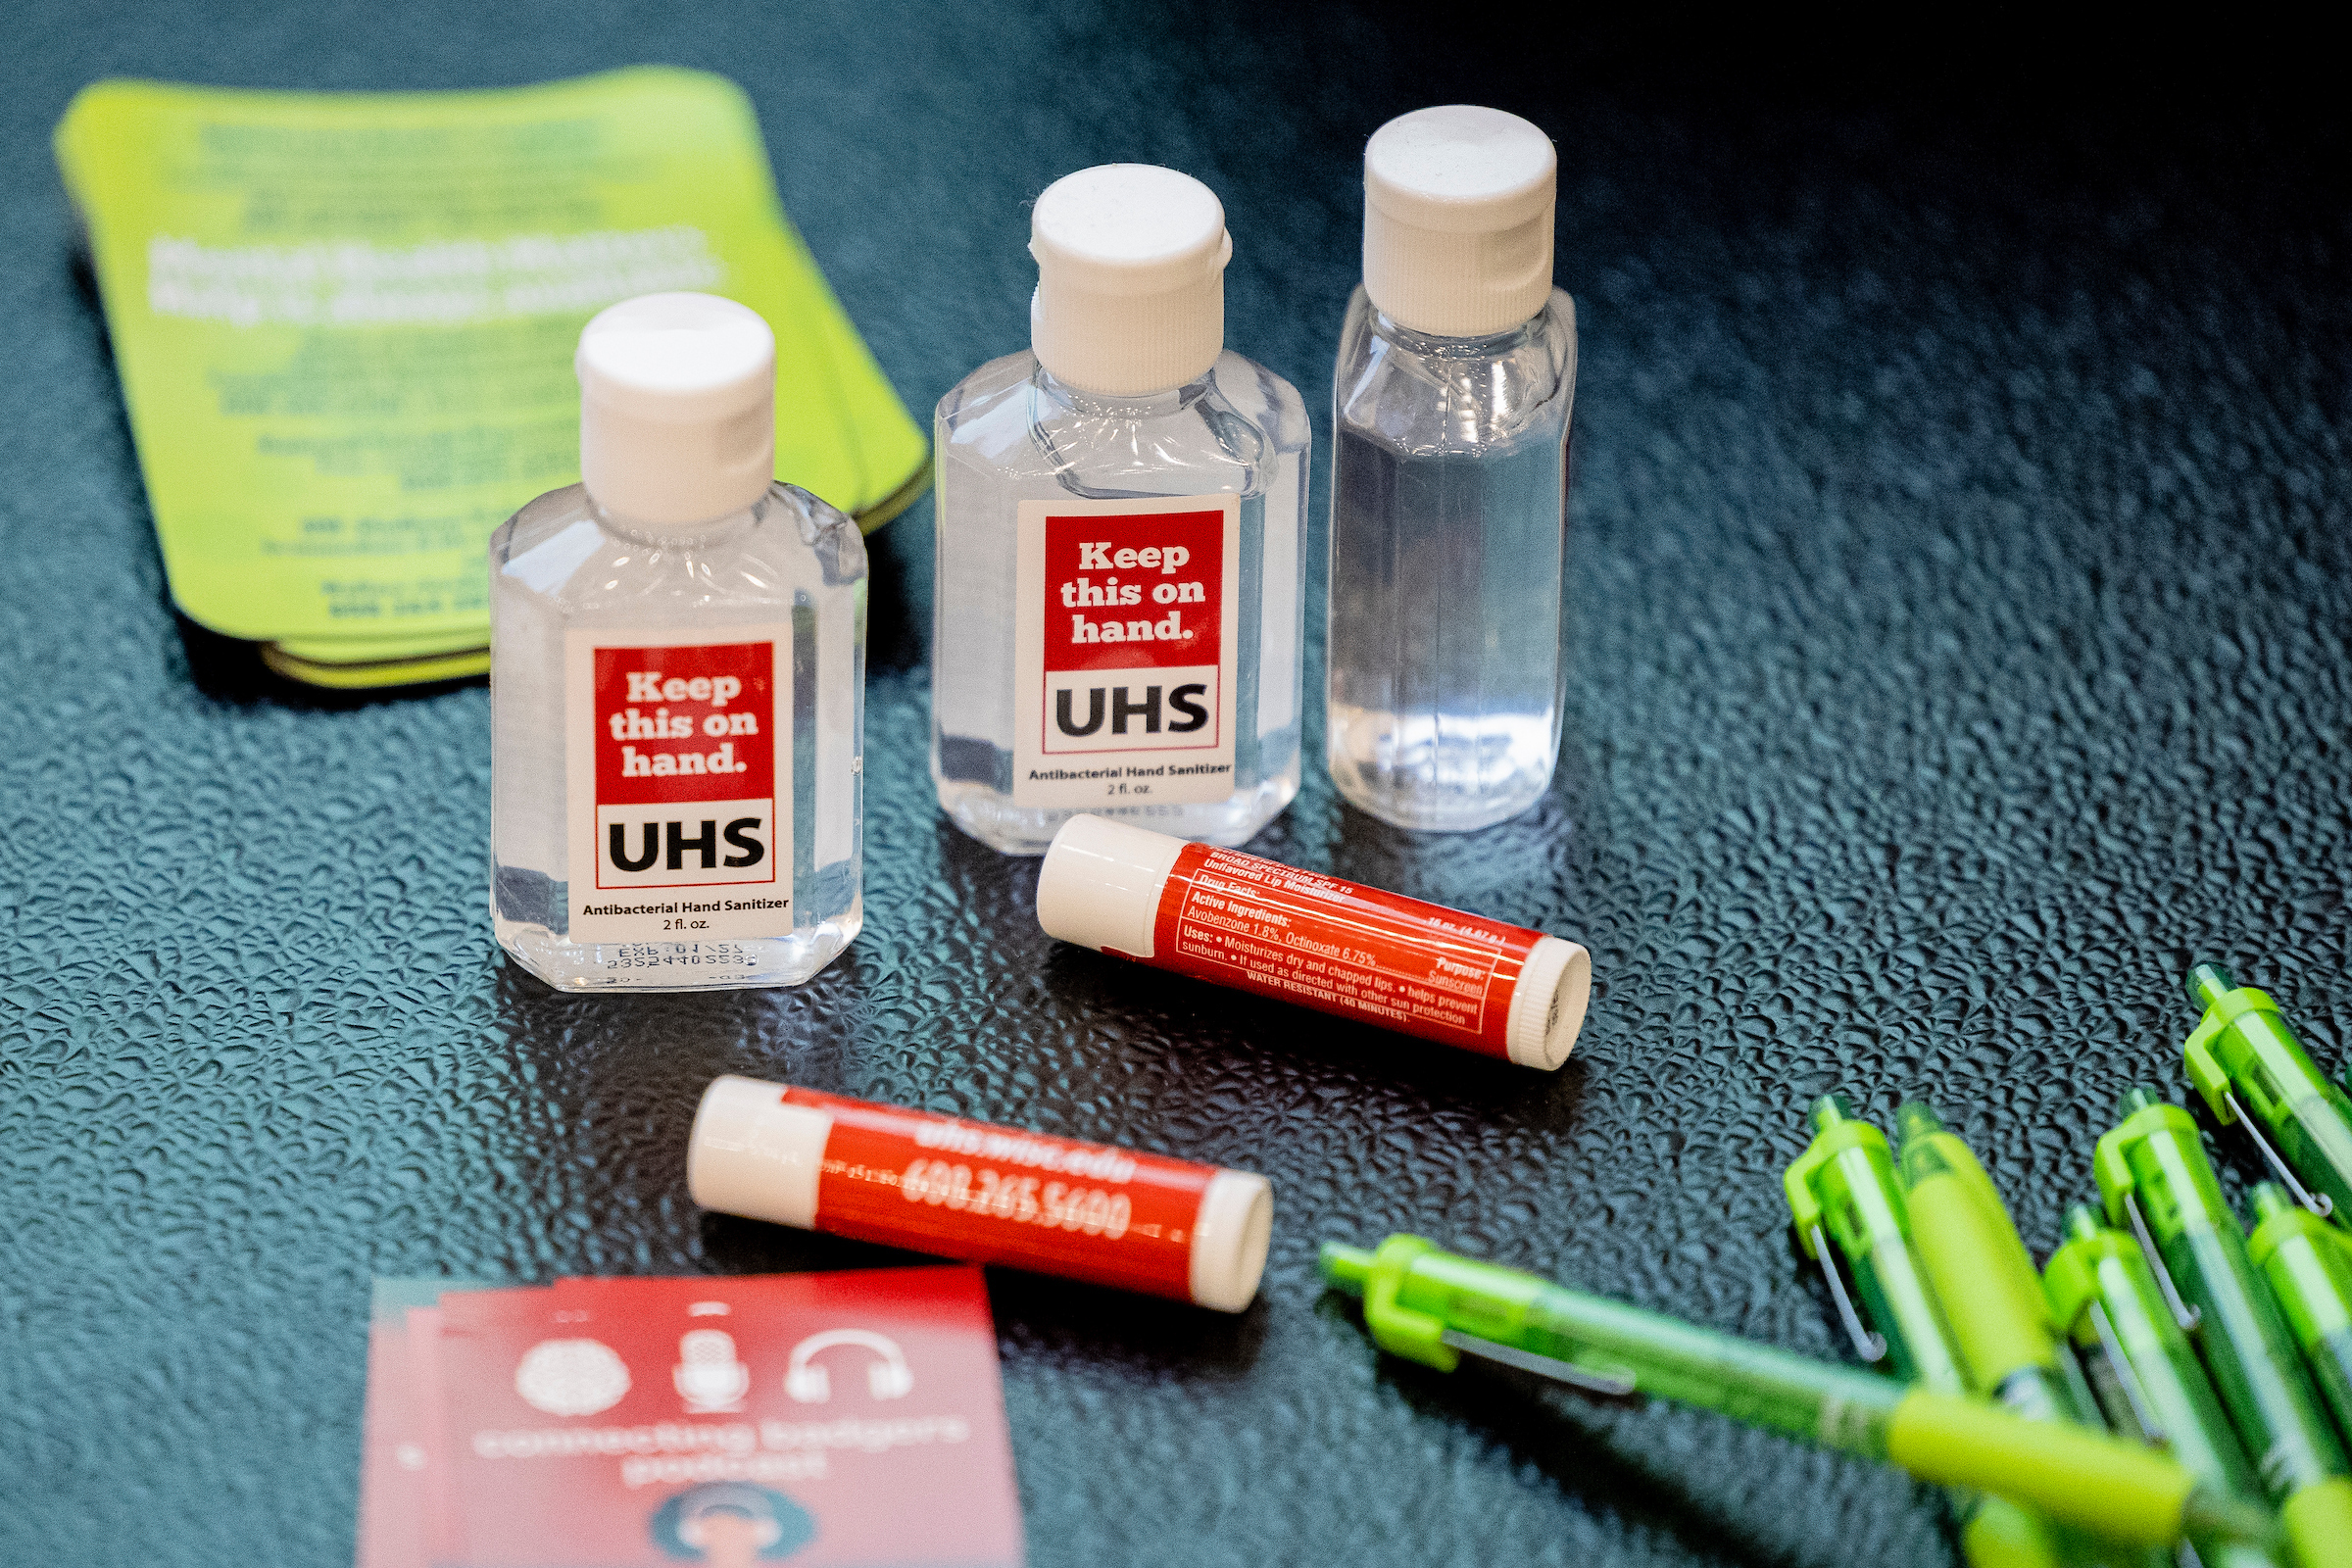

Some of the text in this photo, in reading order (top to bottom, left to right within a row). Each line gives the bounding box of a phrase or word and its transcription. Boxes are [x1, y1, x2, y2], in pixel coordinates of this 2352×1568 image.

[1079, 542, 1190, 574] Keep
[1061, 578, 1205, 608] this on
[1071, 612, 1194, 644] hand.
[626, 671, 742, 707] Keep
[609, 709, 759, 741] this on
[1055, 683, 1209, 738] UHS
[621, 743, 748, 778] hand.
[1029, 763, 1232, 781] Antibacterial Hand Sanitizer
[1107, 783, 1152, 795] 2 fl. oz.
[609, 817, 765, 873] UHS
[1200, 875, 1260, 898] Drug Facts:
[1203, 858, 1345, 903] Unflavored Lip Moisturizer
[1210, 852, 1250, 866] BROAD
[1251, 862, 1311, 883] SPECTRUM
[1312, 879, 1338, 890] SPF
[583, 898, 790, 917] Antibacterial Hand Sanitizer
[663, 918, 710, 931] 2 fl. oz.
[1192, 891, 1293, 929] Active Ingredients:
[1188, 906, 1484, 995] Avobenzone 1.8%, Octinoxate 6.75% Sunscreen
[1182, 941, 1466, 1026] sunburn. If used as directed with other sun protection
[1183, 926, 1478, 1016] Uses: Moisturizes dry and chapped lips. helps prevent
[1436, 957, 1486, 981] Purpose:
[1246, 971, 1411, 1022] WATER RESISTANT (40 MINUTES).
